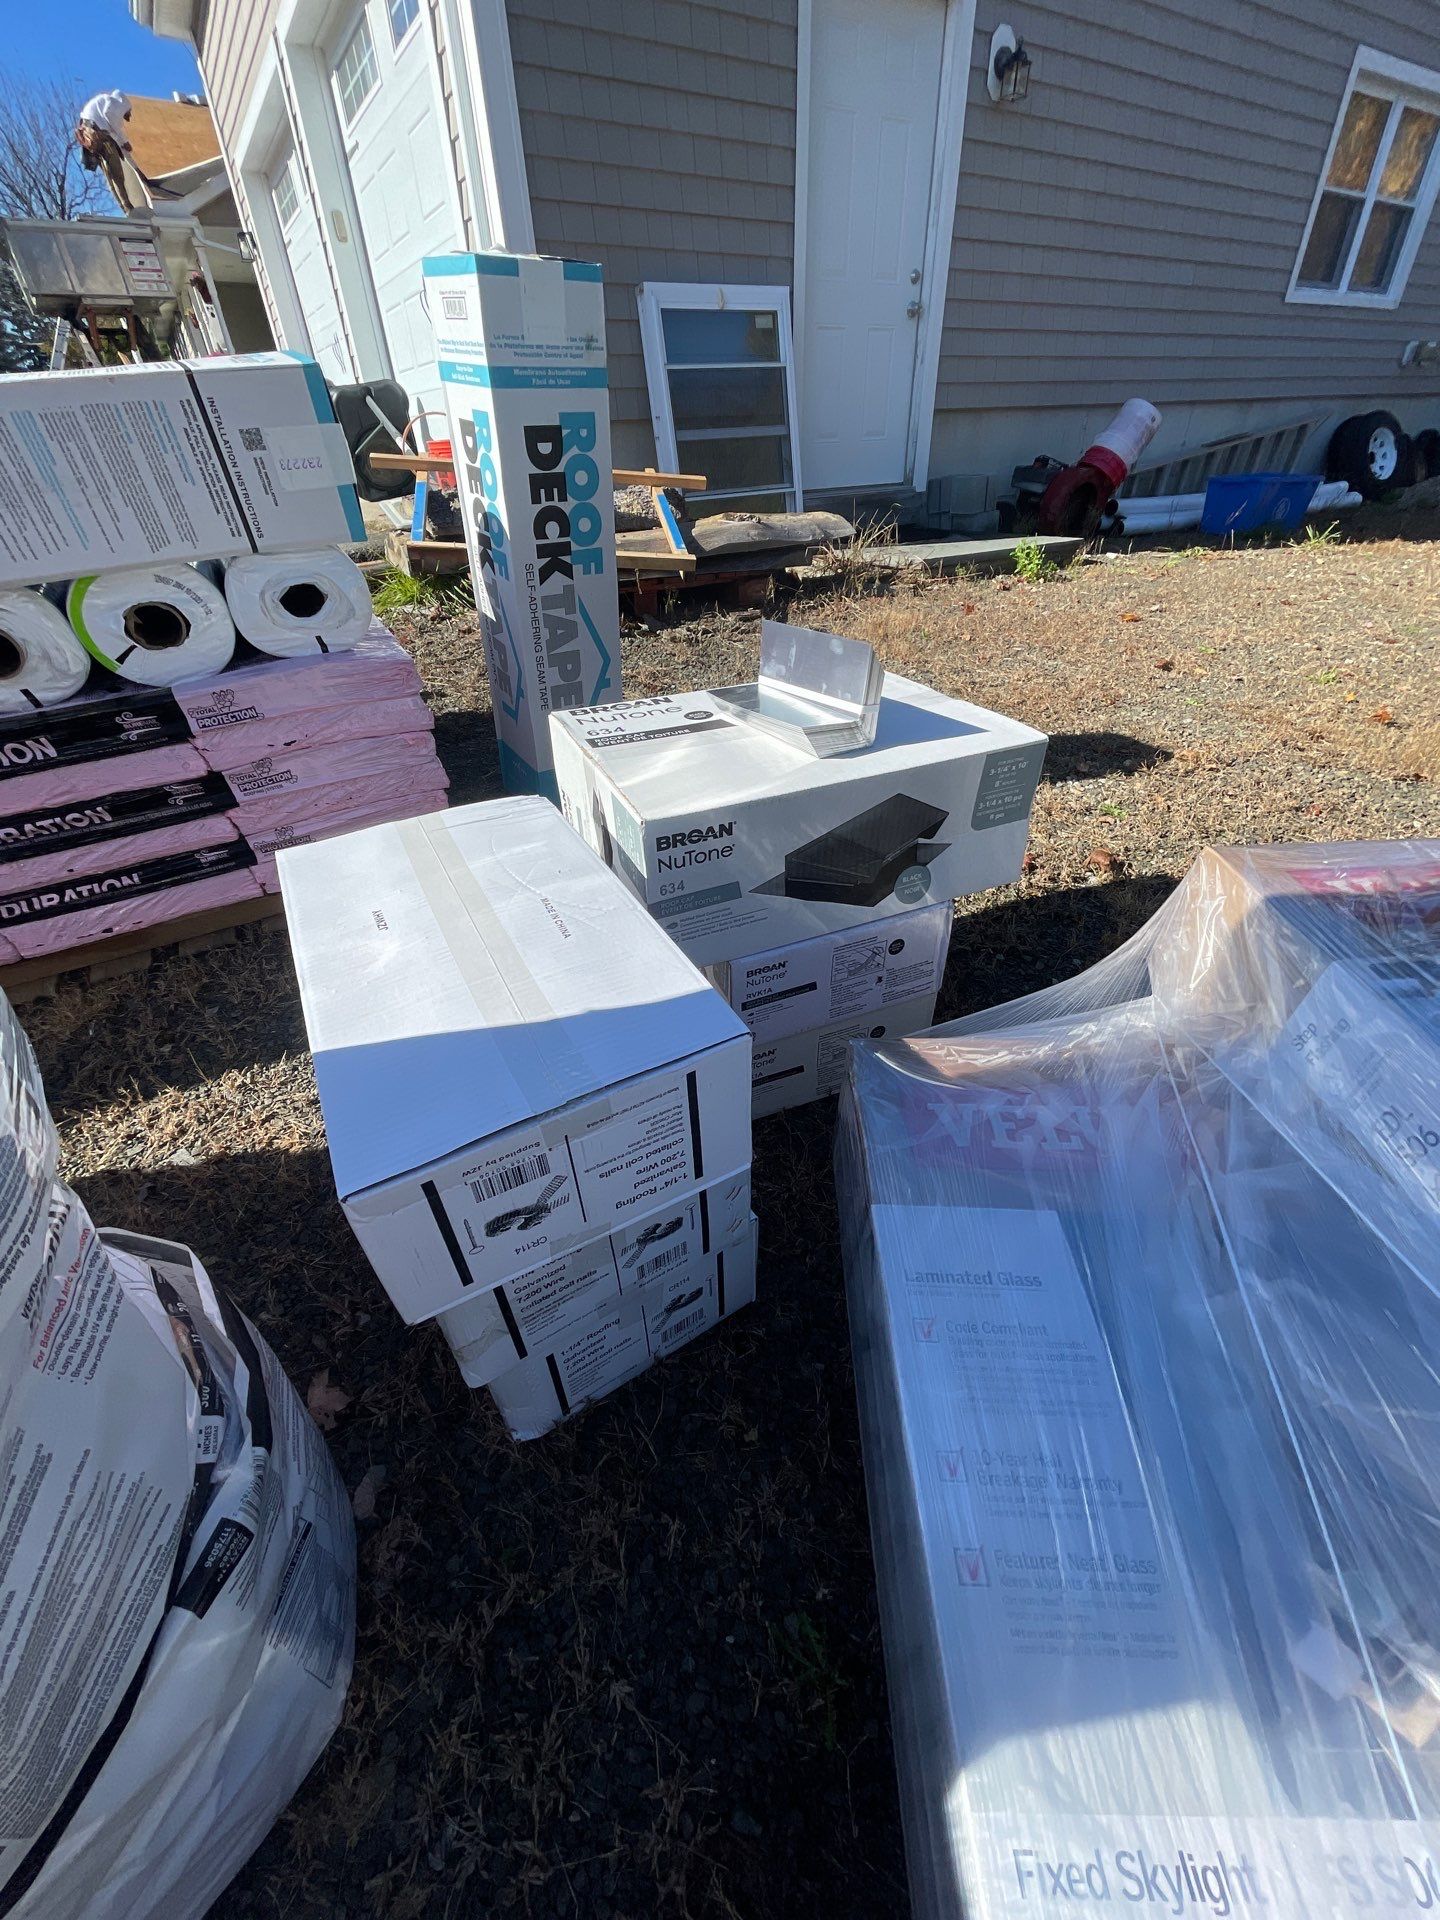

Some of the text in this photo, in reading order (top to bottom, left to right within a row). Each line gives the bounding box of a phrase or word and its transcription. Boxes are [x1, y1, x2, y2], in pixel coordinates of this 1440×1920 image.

[206, 396, 265, 539] INSTALLATION INSTRUCTIONS
[459, 418, 496, 576] DECK
[472, 408, 510, 581] ROOF
[558, 412, 604, 576] ROOF
[524, 425, 585, 710] DECK TAPE
[525, 563, 549, 711] SELF-ADHERING SEAM TAPE
[195, 706, 216, 717] TOTAL
[198, 706, 258, 729] PROTECTION
[568, 696, 674, 717] BROAN
[575, 705, 681, 726] NuTone
[586, 726, 627, 738] 634
[595, 732, 646, 744] ROOF CAP
[649, 728, 691, 740] TOITURE
[235, 772, 256, 783] TOTAL
[239, 770, 293, 792] PROTECTION
[265, 783, 285, 794] SYSTEM
[655, 821, 734, 852] BROAN
[657, 845, 734, 873] NuTone
[659, 880, 686, 896] 634
[902, 873, 923, 883] BLACK
[904, 886, 921, 895] NOIR
[0, 872, 142, 920] DURATION
[540, 897, 554, 915] MADE
[554, 919, 572, 939] CHINA
[746, 961, 787, 979] BROAN
[746, 971, 787, 988] NuTone
[746, 987, 773, 1000] RVK1A
[1293, 1021, 1317, 1053] Step
[461, 1141, 542, 1178] Supplied by JZW
[598, 1137, 684, 1180] collated coil nails
[635, 1151, 686, 1176] 7,200 Wire
[633, 1161, 687, 1190] Galvanized
[615, 1173, 688, 1210] 1-1/4" Roofing
[514, 1235, 548, 1256] CR114
[21, 1263, 44, 1320] VENTSU
[513, 1263, 566, 1295] Galvanized
[515, 1275, 566, 1305] 7,200 Wire
[520, 1292, 557, 1314] collated
[557, 1282, 576, 1295] coil
[576, 1267, 598, 1284] nails
[668, 1275, 691, 1293] CR114
[904, 1269, 1043, 1288] Laminated Glass
[32, 1273, 73, 1370] For Balanced Attic
[560, 1316, 621, 1356] 1-1/4" Roofing
[945, 1320, 1049, 1337] Code Compliant
[48, 1313, 81, 1372] Double-density
[59, 1356, 73, 1376] Lays
[68, 1336, 79, 1357] flat
[78, 1317, 89, 1340] when
[71, 1333, 95, 1378] Breathable
[85, 1305, 120, 1382] Low-profile, straight
[562, 1334, 607, 1365] Galvanized
[567, 1335, 632, 1379] collated coil nails
[564, 1344, 605, 1372] 7,200 Wire
[202, 1424, 214, 1454] INCHES
[1032, 1452, 1063, 1469] Hail
[976, 1471, 1122, 1496] Breakage Warranty
[995, 1551, 1061, 1572] Features
[1111, 1554, 1158, 1575] Glass
[1130, 1581, 1162, 1594] longer
[1012, 1848, 1265, 1917] Fixed Skylight
